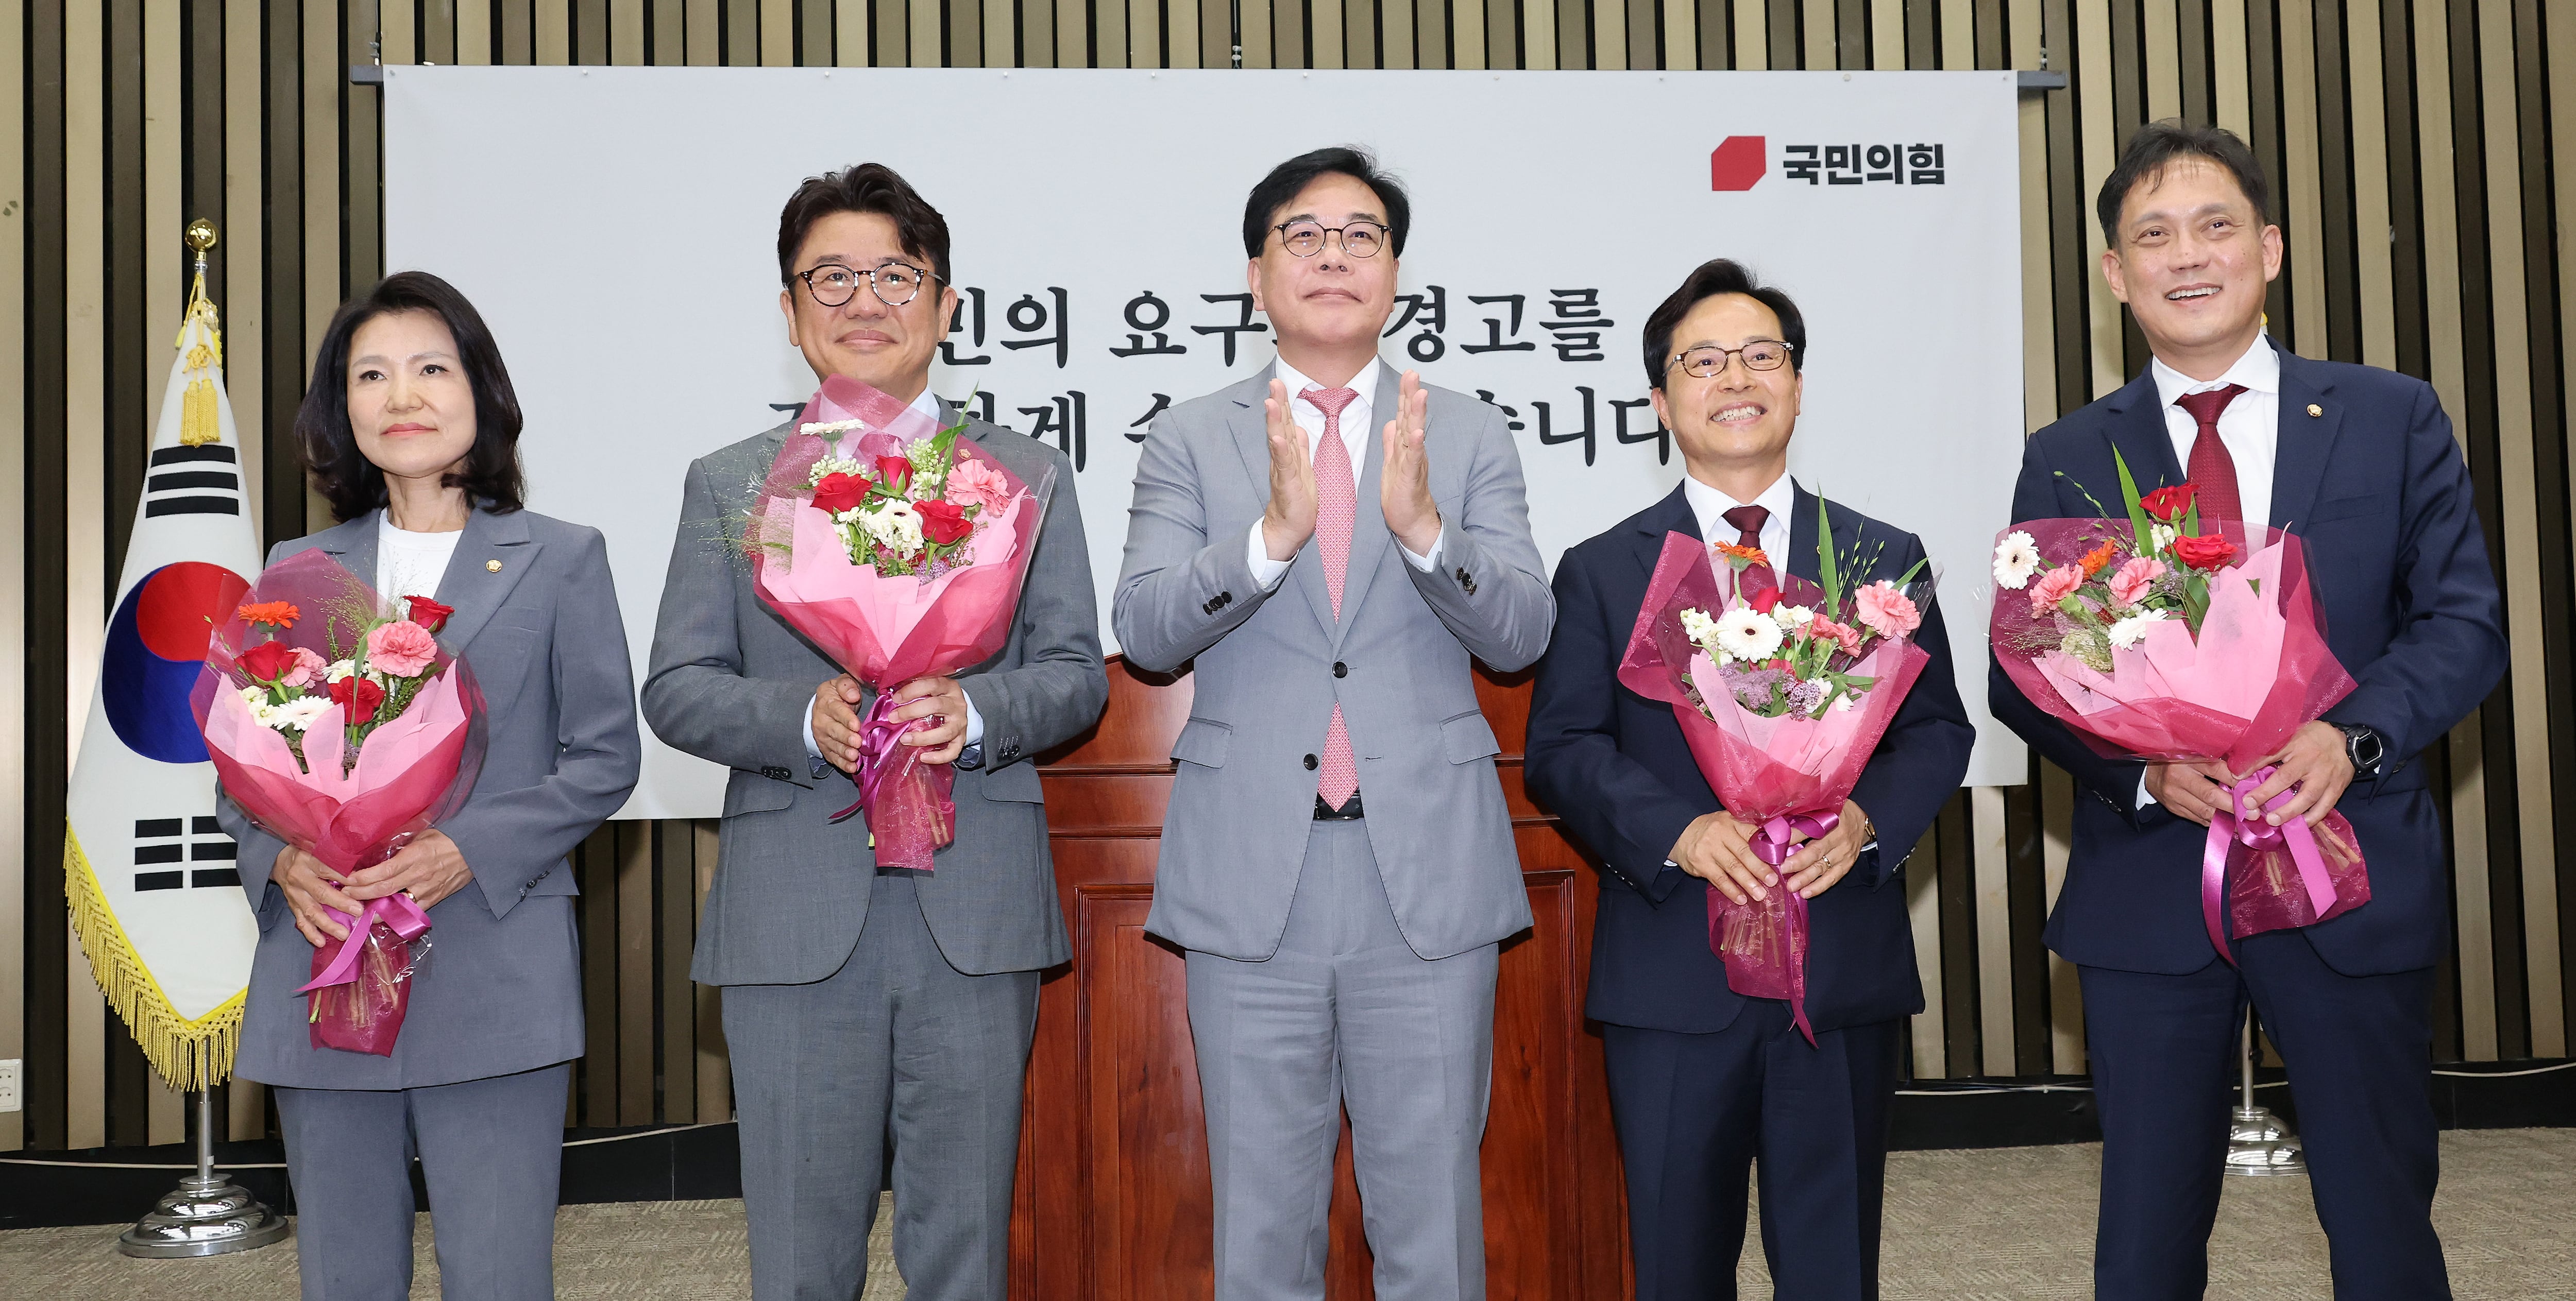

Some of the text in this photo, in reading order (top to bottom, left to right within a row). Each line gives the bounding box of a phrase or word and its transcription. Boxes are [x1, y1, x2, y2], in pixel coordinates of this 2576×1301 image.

[1783, 143, 1945, 185] 국민의힘
[938, 285, 1615, 369] 민의 요구 경고를
